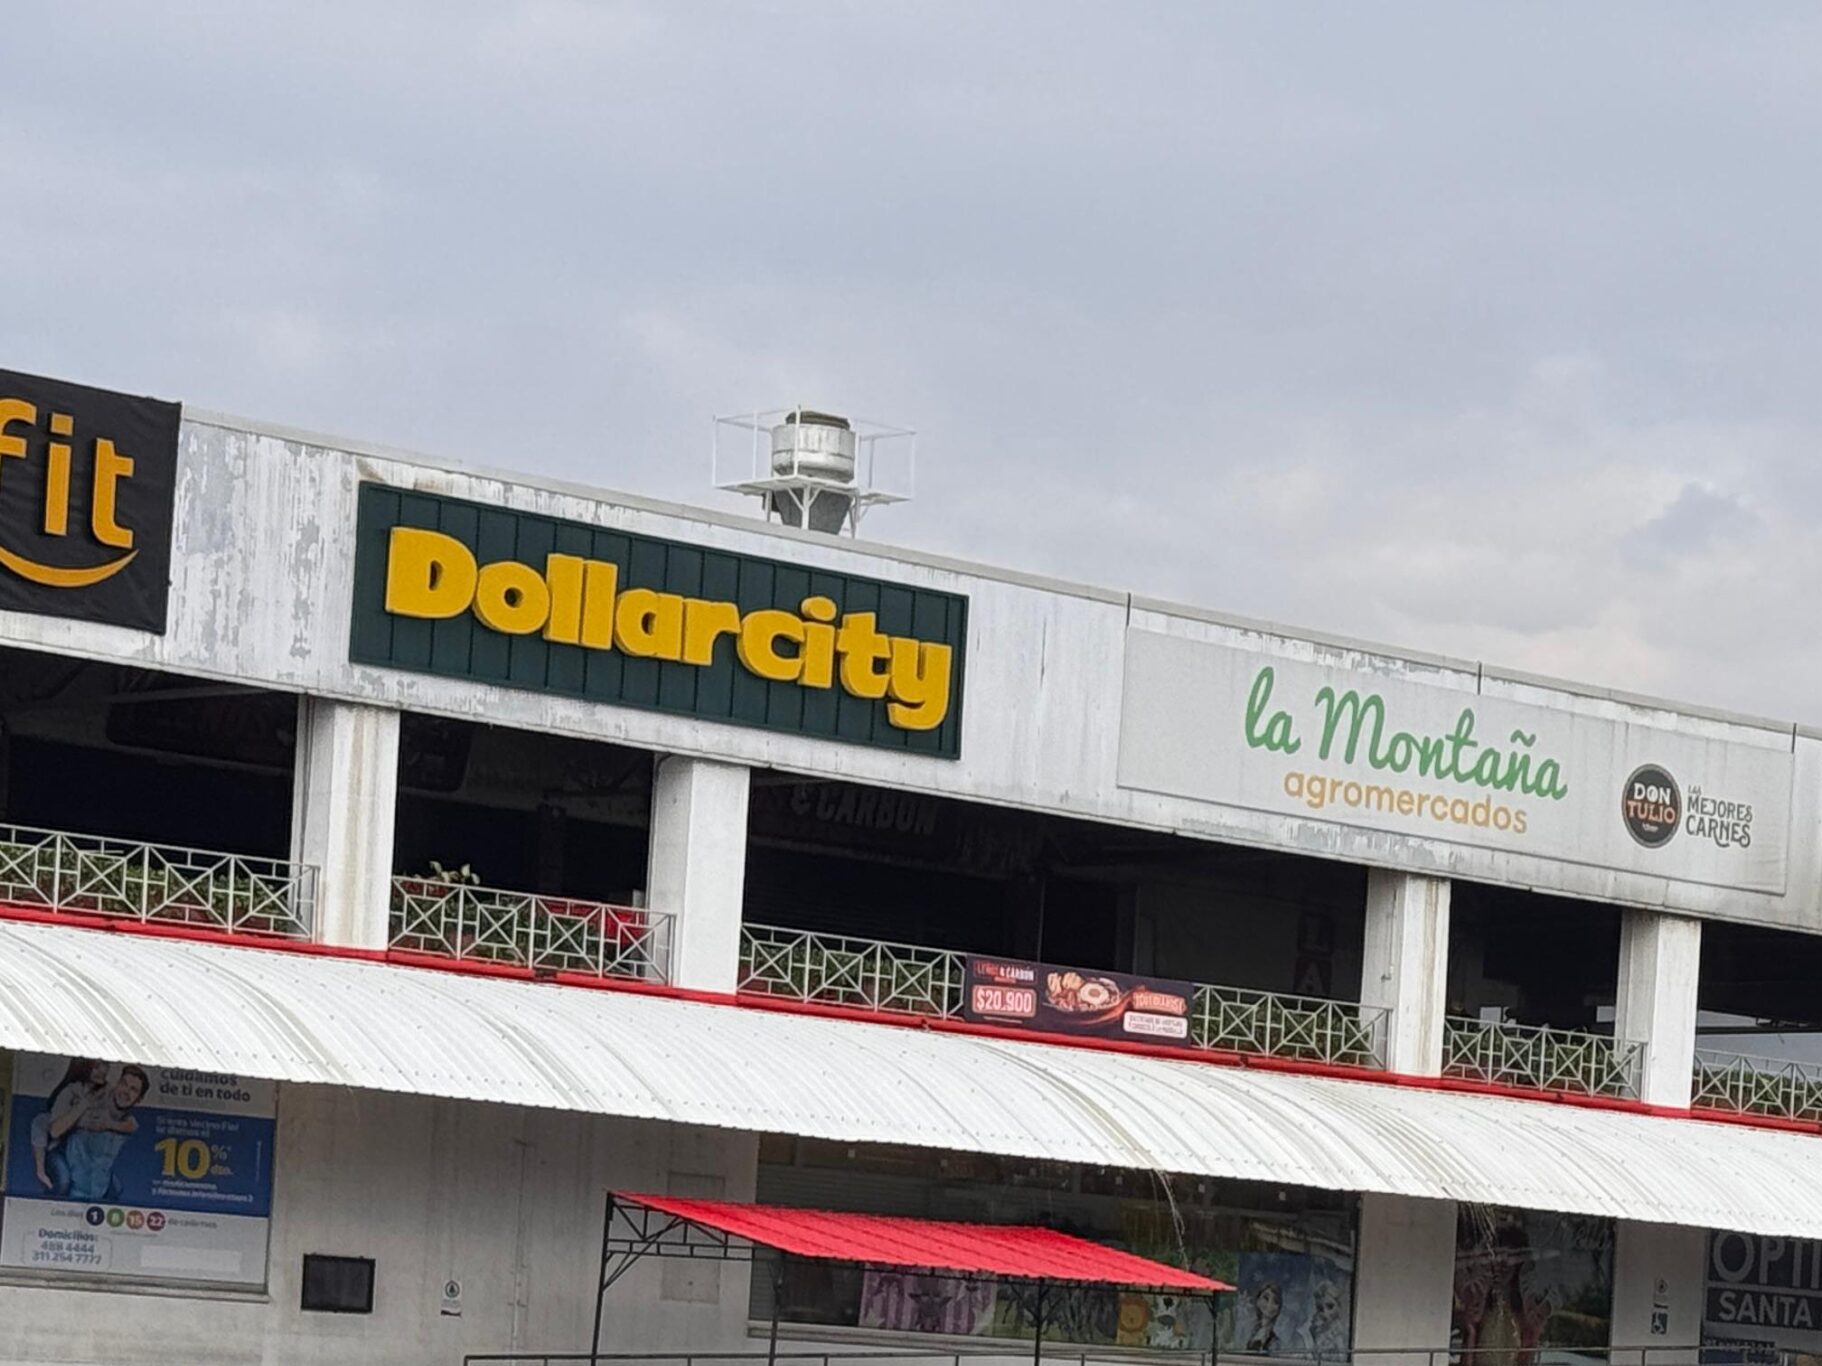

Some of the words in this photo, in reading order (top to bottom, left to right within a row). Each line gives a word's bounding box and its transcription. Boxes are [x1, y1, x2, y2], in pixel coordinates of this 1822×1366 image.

[385, 526, 953, 731] Dollarcity
[1244, 665, 1302, 755] la
[1314, 685, 1569, 800] Montaña
[1283, 770, 1529, 835] agromercados
[1633, 781, 1672, 806] DON
[1686, 793, 1754, 824] MEJORES
[1626, 799, 1677, 825] TULIO
[1685, 814, 1752, 849] CARNES
[976, 988, 1033, 1014] $20.900
[160, 1082, 179, 1095] de
[182, 1084, 193, 1096] ti
[195, 1087, 213, 1099] en
[216, 1087, 251, 1102] todo
[1717, 1290, 1815, 1330] SANTA
